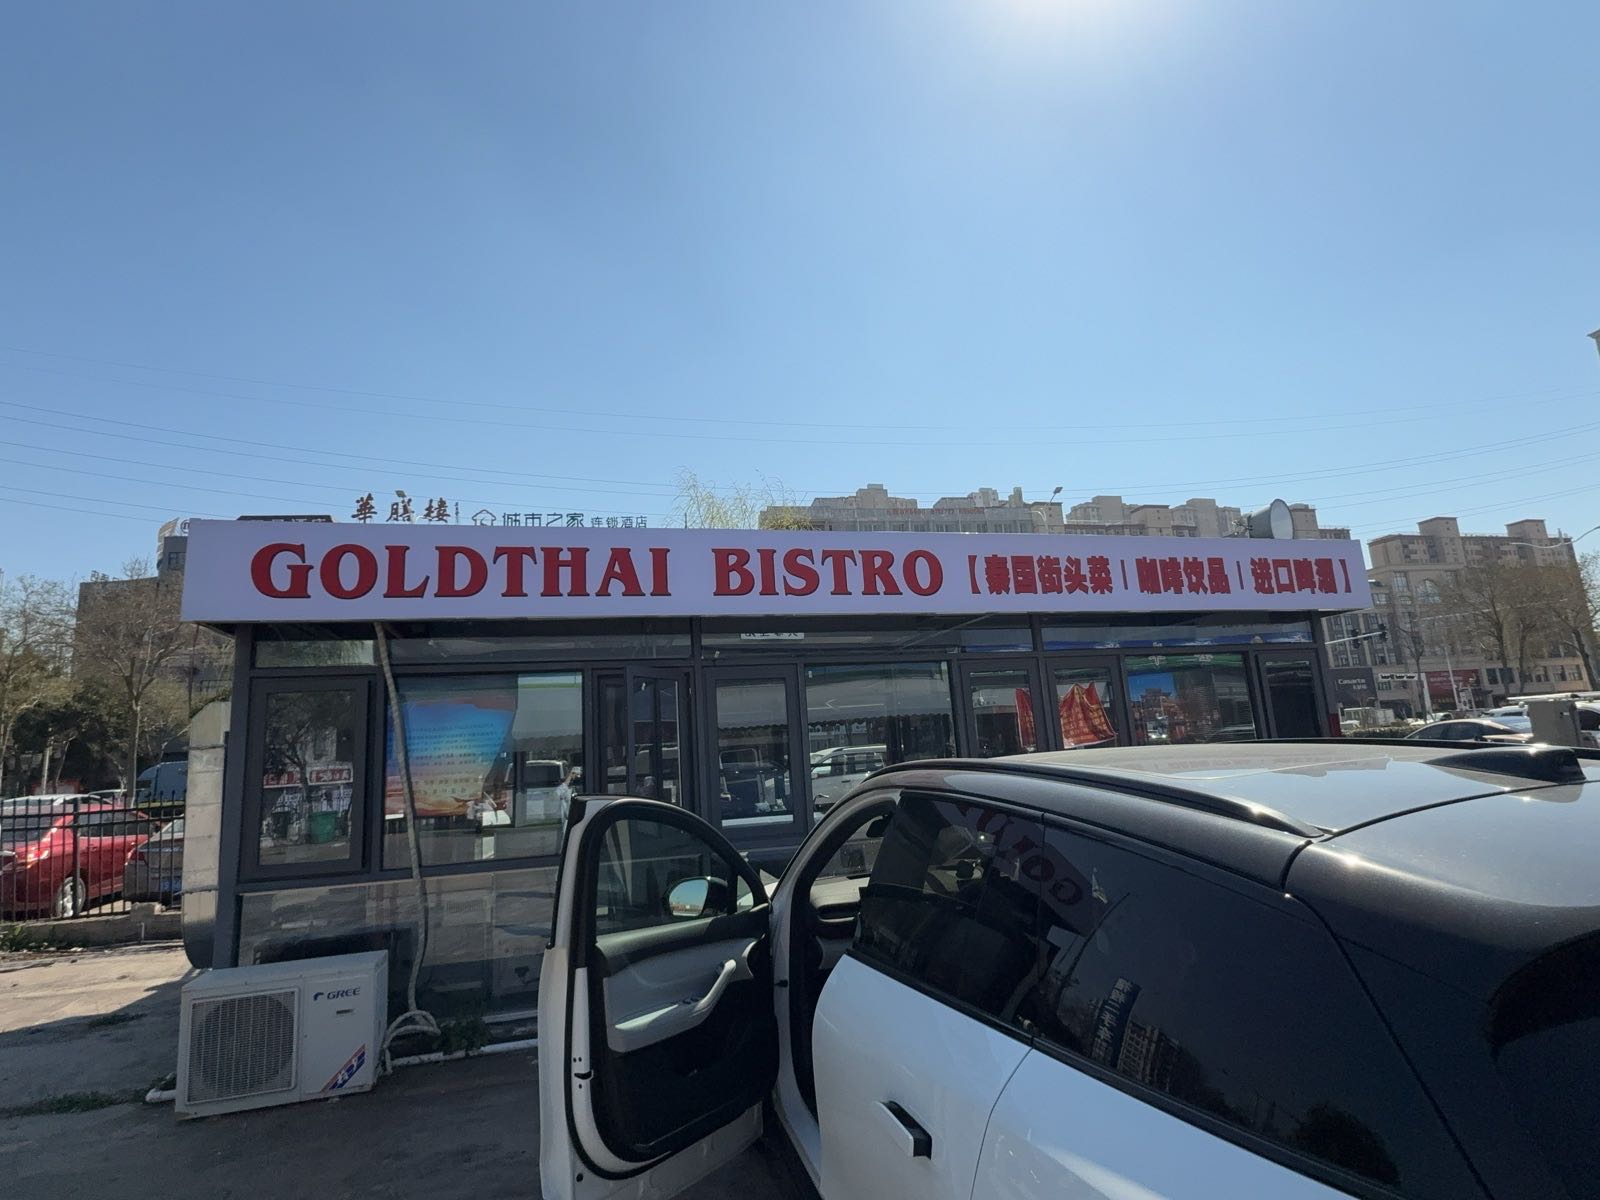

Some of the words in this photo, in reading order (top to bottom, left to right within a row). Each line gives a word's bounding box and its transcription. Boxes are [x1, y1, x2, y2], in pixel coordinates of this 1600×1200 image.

[502, 512, 586, 528] 城市之家
[590, 515, 648, 529] 连锁酒店
[250, 542, 672, 600] GOLDTHAI
[711, 548, 944, 597] BISTRO
[327, 987, 361, 1000] GREE
